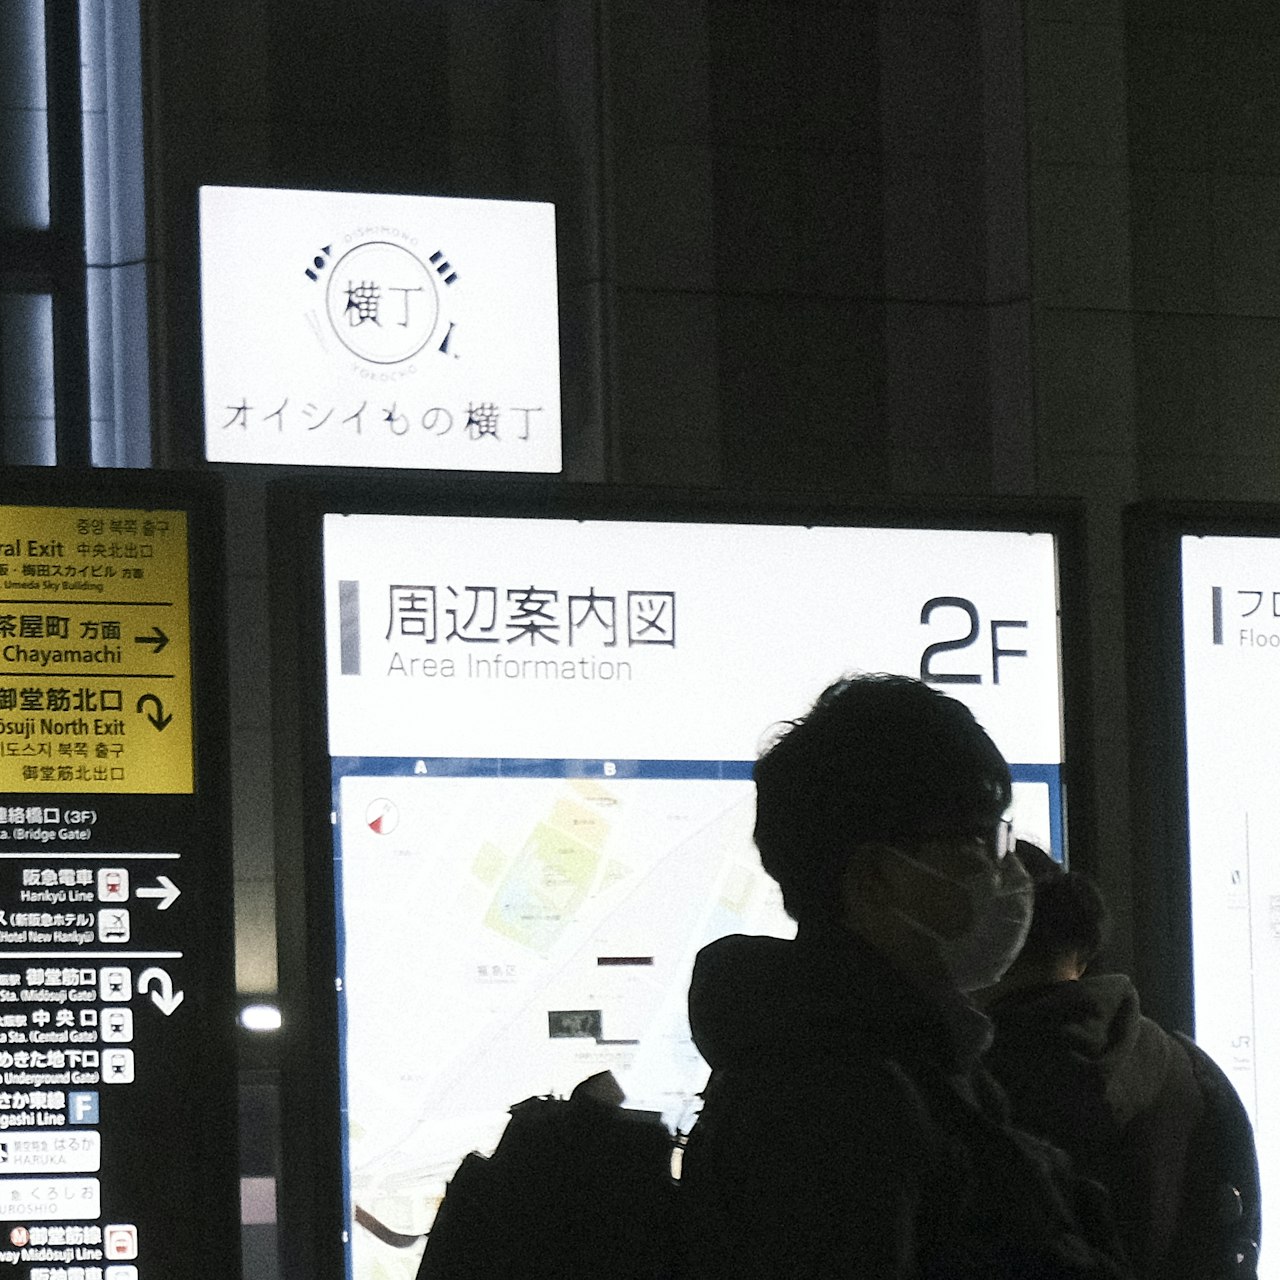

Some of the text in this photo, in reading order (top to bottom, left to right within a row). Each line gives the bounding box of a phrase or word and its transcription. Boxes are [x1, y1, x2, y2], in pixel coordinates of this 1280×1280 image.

[343, 279, 425, 328] 横丁
[222, 397, 545, 442] オイシイもの横丁
[28, 541, 64, 558] Exit
[78, 542, 152, 558] 中央北出口
[4, 580, 39, 590] Umeda
[43, 581, 60, 592] Sky
[62, 581, 103, 593] Building
[385, 583, 678, 649] 周辺案内図
[79, 621, 121, 640] 方面
[919, 594, 1029, 686] 2F
[3, 645, 121, 667] Chayamachi
[387, 653, 633, 682] Area Information
[41, 719, 88, 736] North
[94, 719, 125, 736] Exit
[22, 766, 125, 782] 御堂筋北出口
[414, 760, 427, 774] A
[604, 762, 616, 776] B
[63, 810, 97, 825] (3F)
[13, 828, 57, 843] (Bridge
[58, 828, 91, 841] Gate)
[22, 869, 94, 886] 阪急電車
[68, 890, 94, 902] Line
[29, 931, 51, 943] New
[0, 990, 19, 1002] Sta.
[69, 989, 97, 1002] Gate)
[9, 1030, 29, 1043] Sta.
[29, 1030, 68, 1043] (Central
[70, 1030, 98, 1043] Gate)
[4, 1071, 70, 1087] Underground
[71, 1071, 99, 1084] Gate)
[37, 1112, 65, 1126] Line
[54, 1137, 95, 1151] はるか
[14, 1154, 67, 1165] HARUKA
[31, 1186, 94, 1200] くろしお
[75, 1247, 103, 1261] Line
